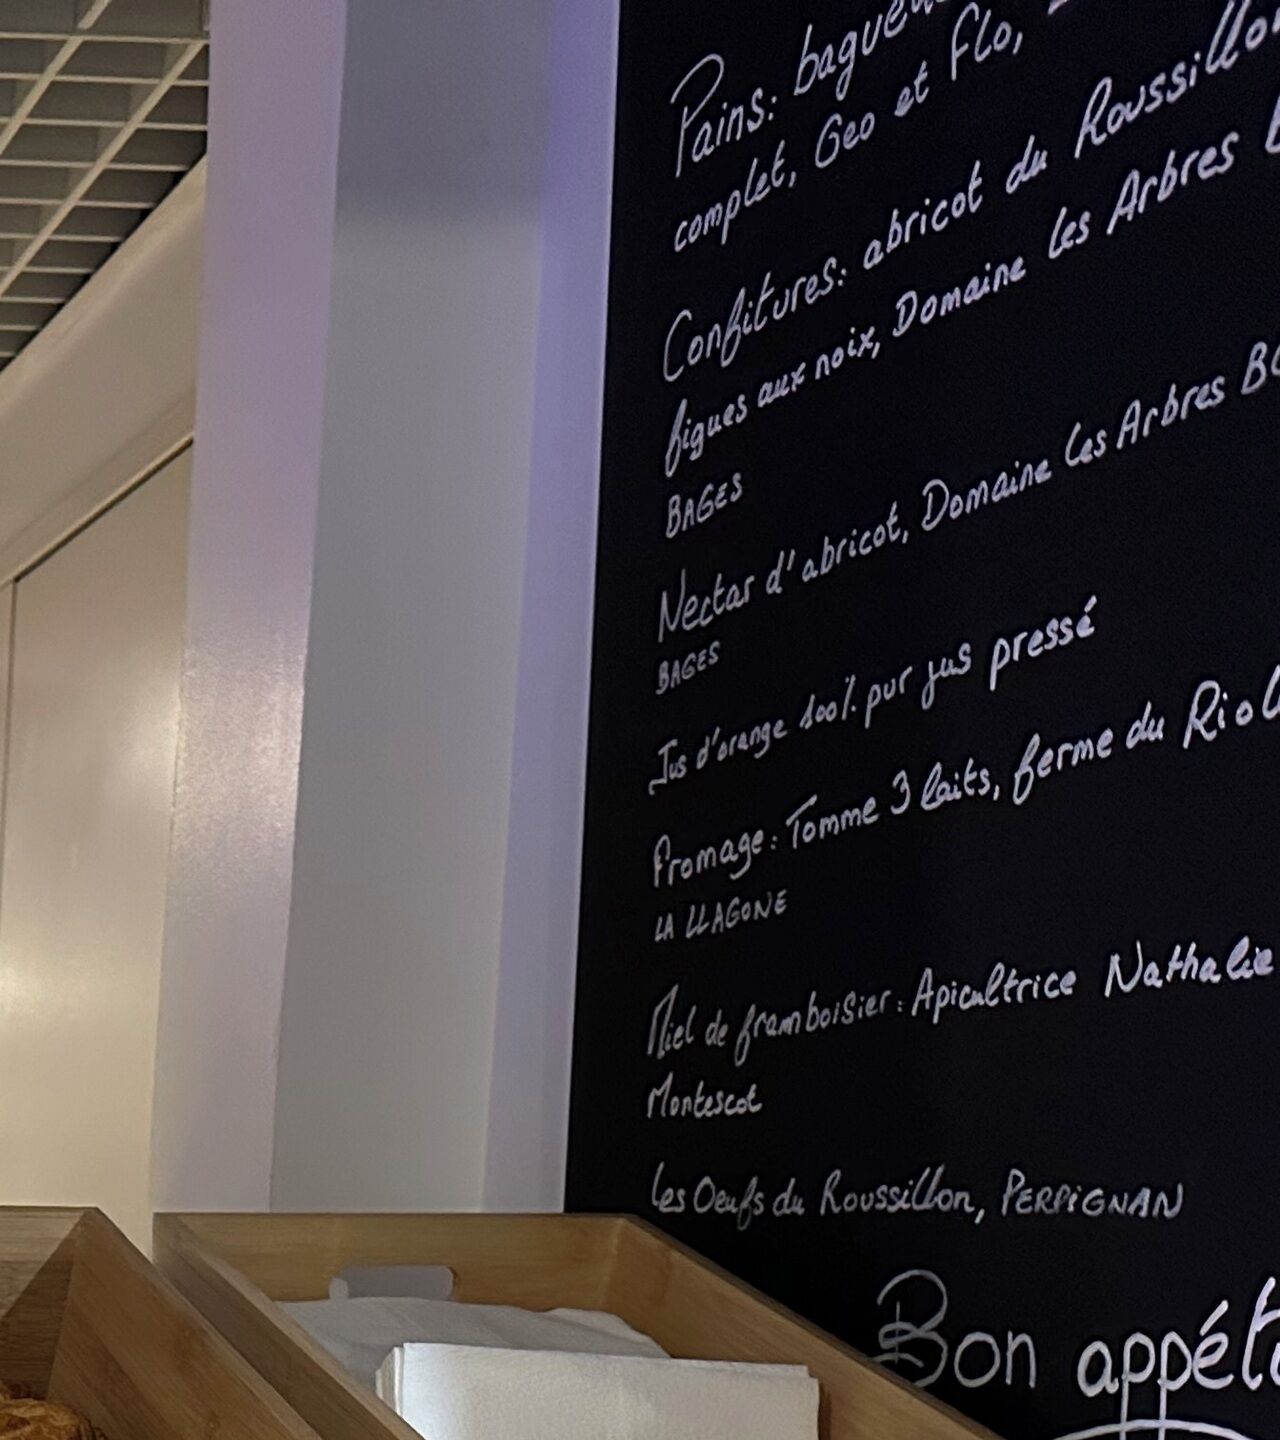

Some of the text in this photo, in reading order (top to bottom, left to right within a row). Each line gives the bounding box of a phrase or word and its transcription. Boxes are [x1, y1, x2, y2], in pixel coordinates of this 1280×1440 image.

[670, 0, 938, 178] Pains: bague
[674, 139, 798, 253] complet,
[814, 112, 876, 169] Geo
[894, 59, 931, 118] et
[663, 255, 848, 383] Confitures:
[863, 159, 983, 271] abricot
[1006, 134, 1048, 192] du
[664, 398, 748, 479] figues
[756, 367, 806, 408] aux
[815, 326, 881, 384] noix,
[892, 255, 1028, 339] Domaine
[1106, 130, 1240, 236] Arbres
[658, 567, 756, 643] Nectar
[920, 459, 1053, 532] Domaine
[1116, 375, 1226, 449] Arbres
[665, 472, 744, 539] BAGES
[648, 738, 688, 796] Jus
[695, 716, 789, 772] d'orange
[864, 665, 914, 729] pur
[920, 643, 973, 711] jus
[989, 594, 1098, 693] pressé
[655, 639, 721, 696] BAGES
[786, 794, 880, 850] Tomme
[891, 769, 912, 814] 3
[920, 758, 1001, 812] laits,
[1012, 729, 1114, 806] ferme
[1124, 700, 1166, 750] du
[1182, 662, 1280, 750] Riol
[653, 886, 789, 943] LA LLAGONE
[647, 983, 698, 1060] Miel
[704, 1006, 730, 1049] de
[911, 961, 1079, 1025] Apicultrice
[1104, 935, 1277, 998] Nathalie
[646, 1070, 763, 1119] Montescot
[691, 1174, 765, 1232] Oeufs
[771, 1178, 806, 1217] du
[819, 1164, 987, 1226] Roussillon,
[872, 1267, 1038, 1390] Bon
